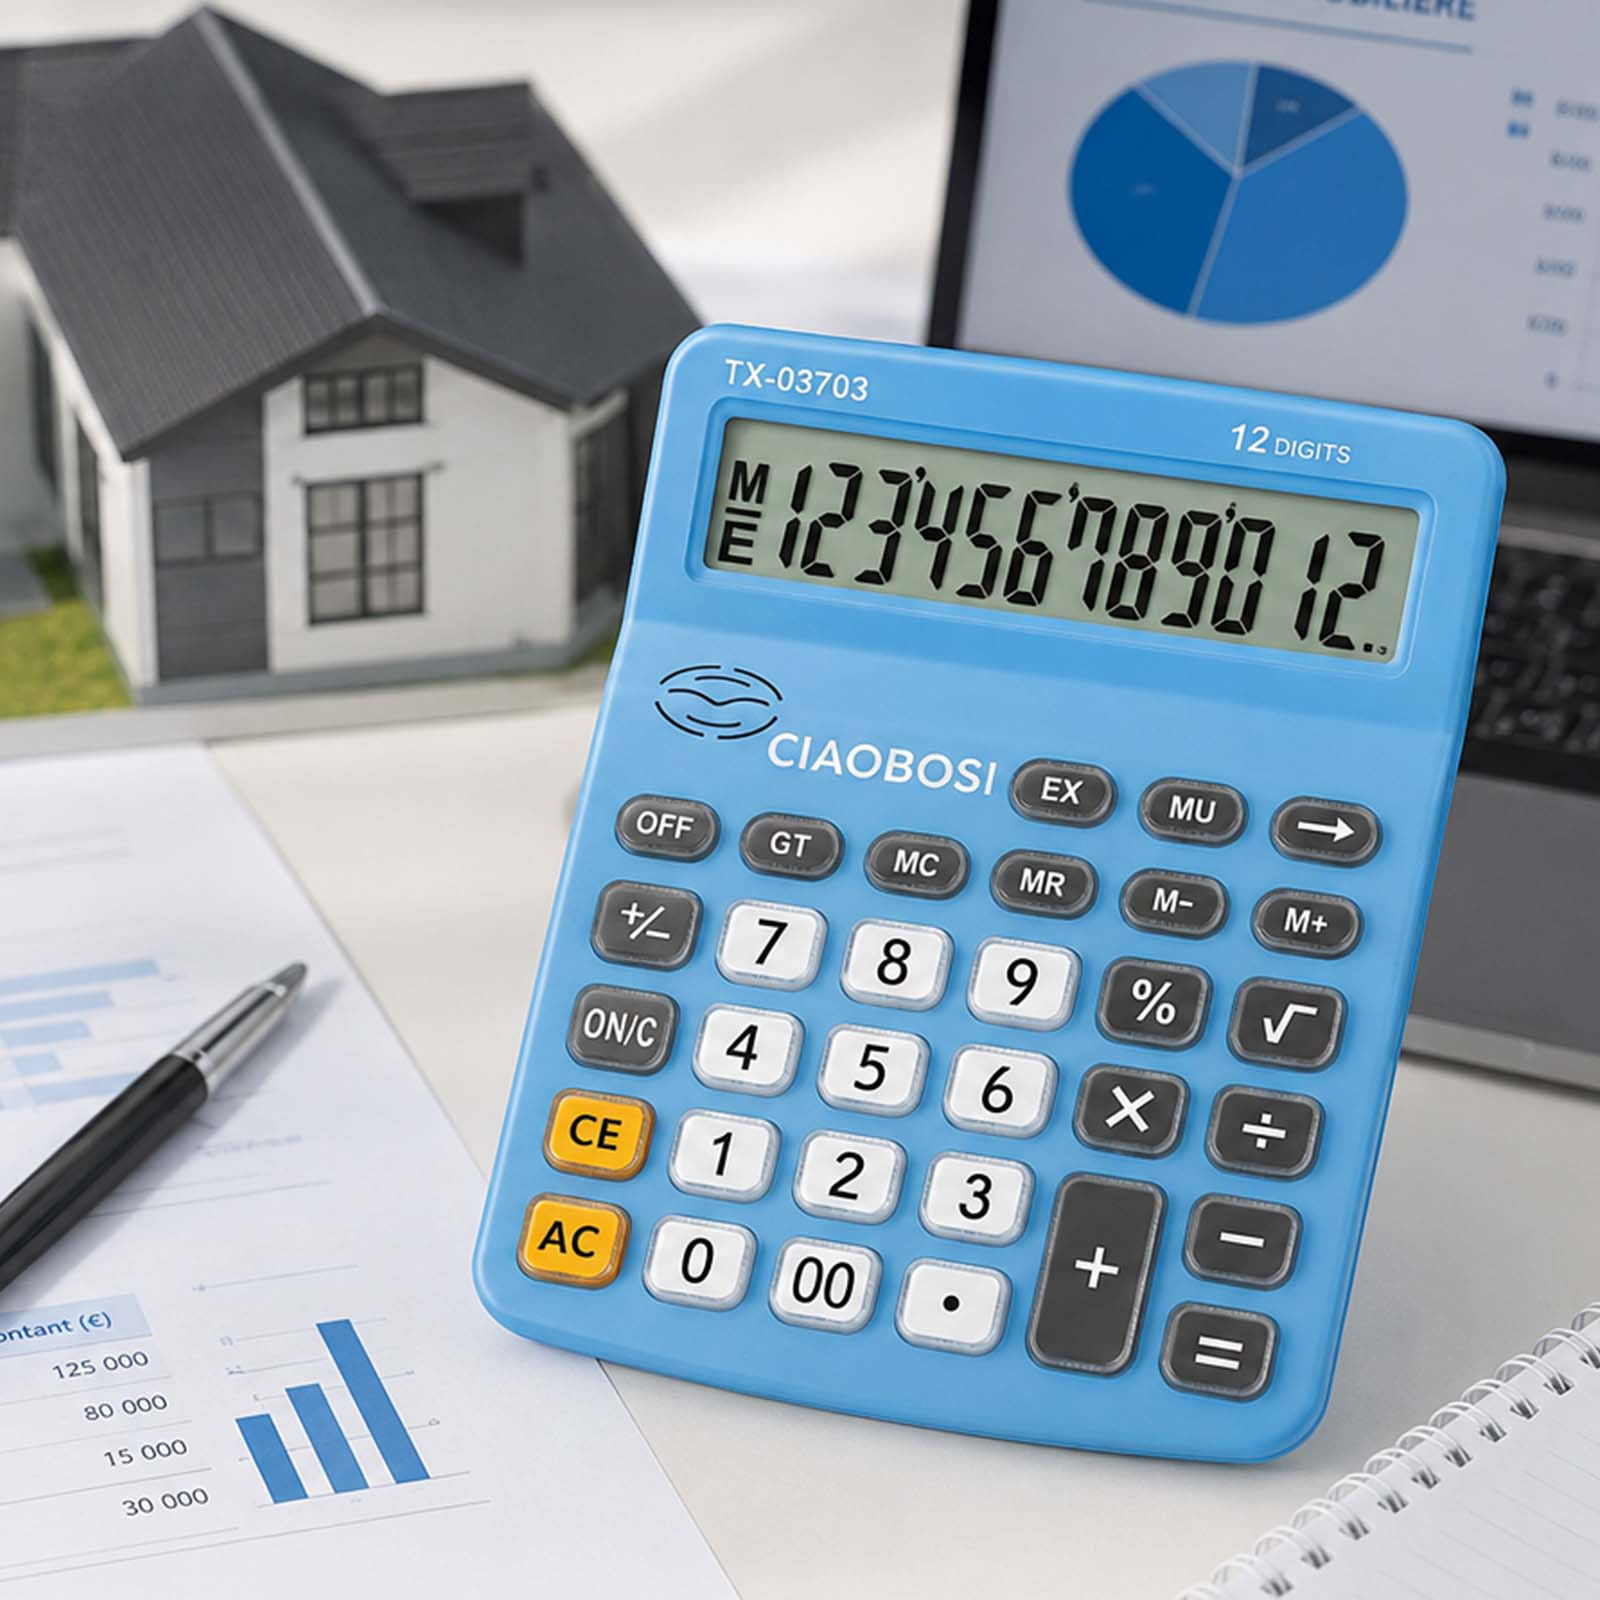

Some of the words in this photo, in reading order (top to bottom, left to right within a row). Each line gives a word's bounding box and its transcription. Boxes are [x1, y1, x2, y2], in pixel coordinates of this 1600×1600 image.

[725, 358, 869, 401] TX-03703
[1231, 423, 1270, 454] 12
[1274, 437, 1351, 464] DIGITS
[728, 460, 770, 504] M
[717, 521, 758, 566] E
[767, 732, 998, 796] CIAOBOSI
[1041, 776, 1083, 805] EX
[1169, 795, 1216, 824] MU
[636, 811, 694, 839] OFF
[770, 831, 812, 859] GT
[893, 849, 940, 878] MC
[1019, 867, 1065, 897] MR
[756, 918, 788, 965] 7
[1284, 907, 1328, 934] M+
[876, 938, 912, 986] 8
[1006, 958, 1038, 1006] 9
[1132, 978, 1176, 1025] %
[583, 1008, 658, 1048] ON/C
[726, 1024, 759, 1071] 4
[857, 1044, 890, 1091] 5
[981, 1066, 1013, 1114] 6
[569, 1114, 623, 1151] CE
[712, 1131, 733, 1176] 1
[829, 1151, 865, 1200] 2
[959, 1173, 992, 1220] 3
[537, 1220, 600, 1259] AC
[681, 1237, 714, 1284] 0
[792, 1256, 855, 1309] 00
[79, 1311, 112, 1333] (€)
[52, 1359, 97, 1380] 125
[102, 1350, 149, 1372] 000
[83, 1402, 115, 1421] 80
[121, 1394, 168, 1415] 000
[103, 1447, 135, 1467] 15
[140, 1439, 188, 1461] 000
[121, 1496, 155, 1517] 30
[160, 1487, 209, 1510] 000
